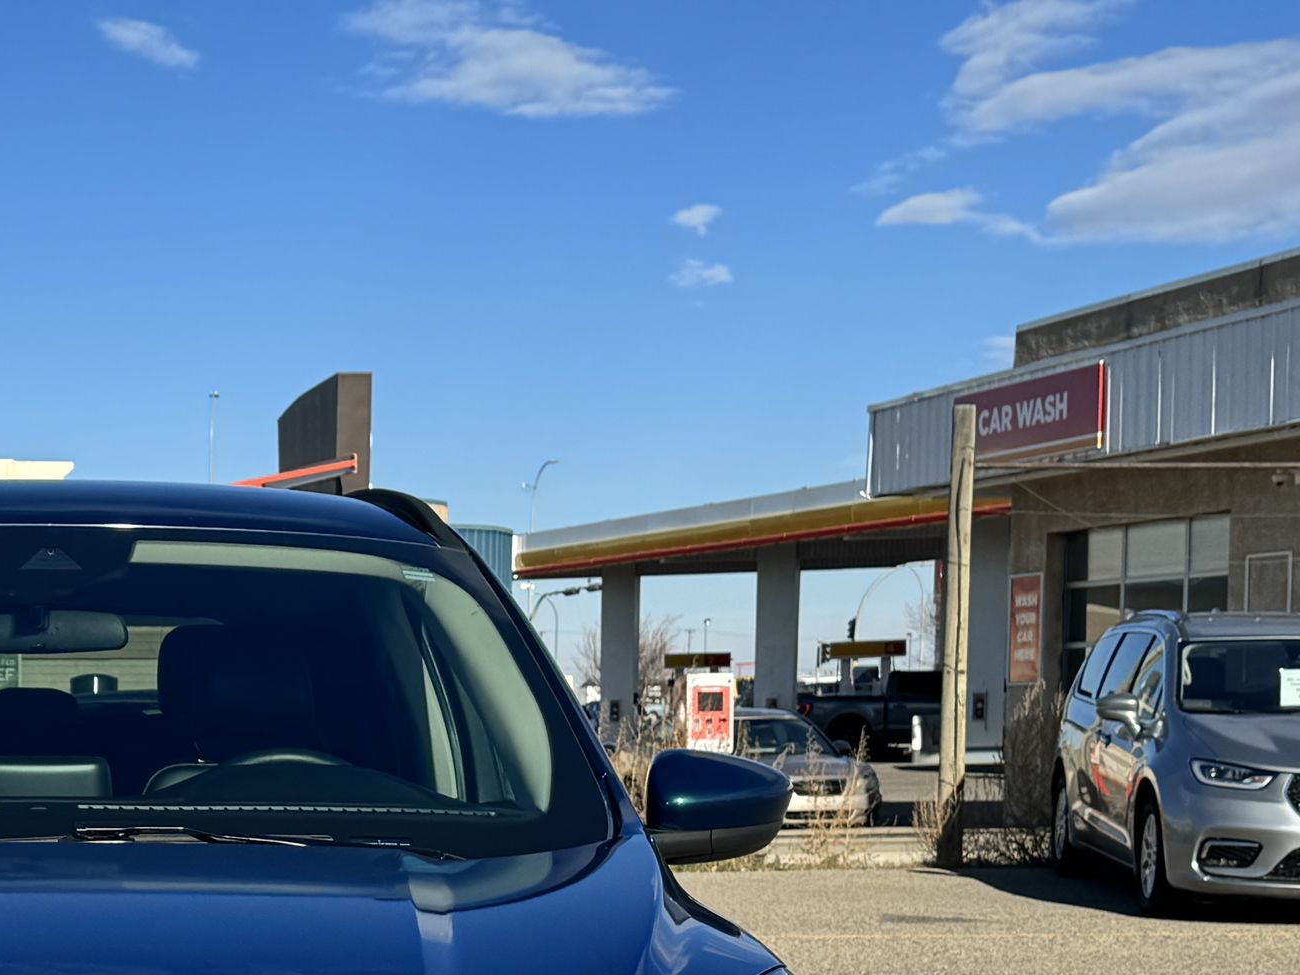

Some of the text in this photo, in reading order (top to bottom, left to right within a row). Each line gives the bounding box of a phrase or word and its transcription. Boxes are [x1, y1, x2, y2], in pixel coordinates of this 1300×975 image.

[978, 391, 1068, 436] CAR WASH
[1015, 593, 1038, 608] WASH
